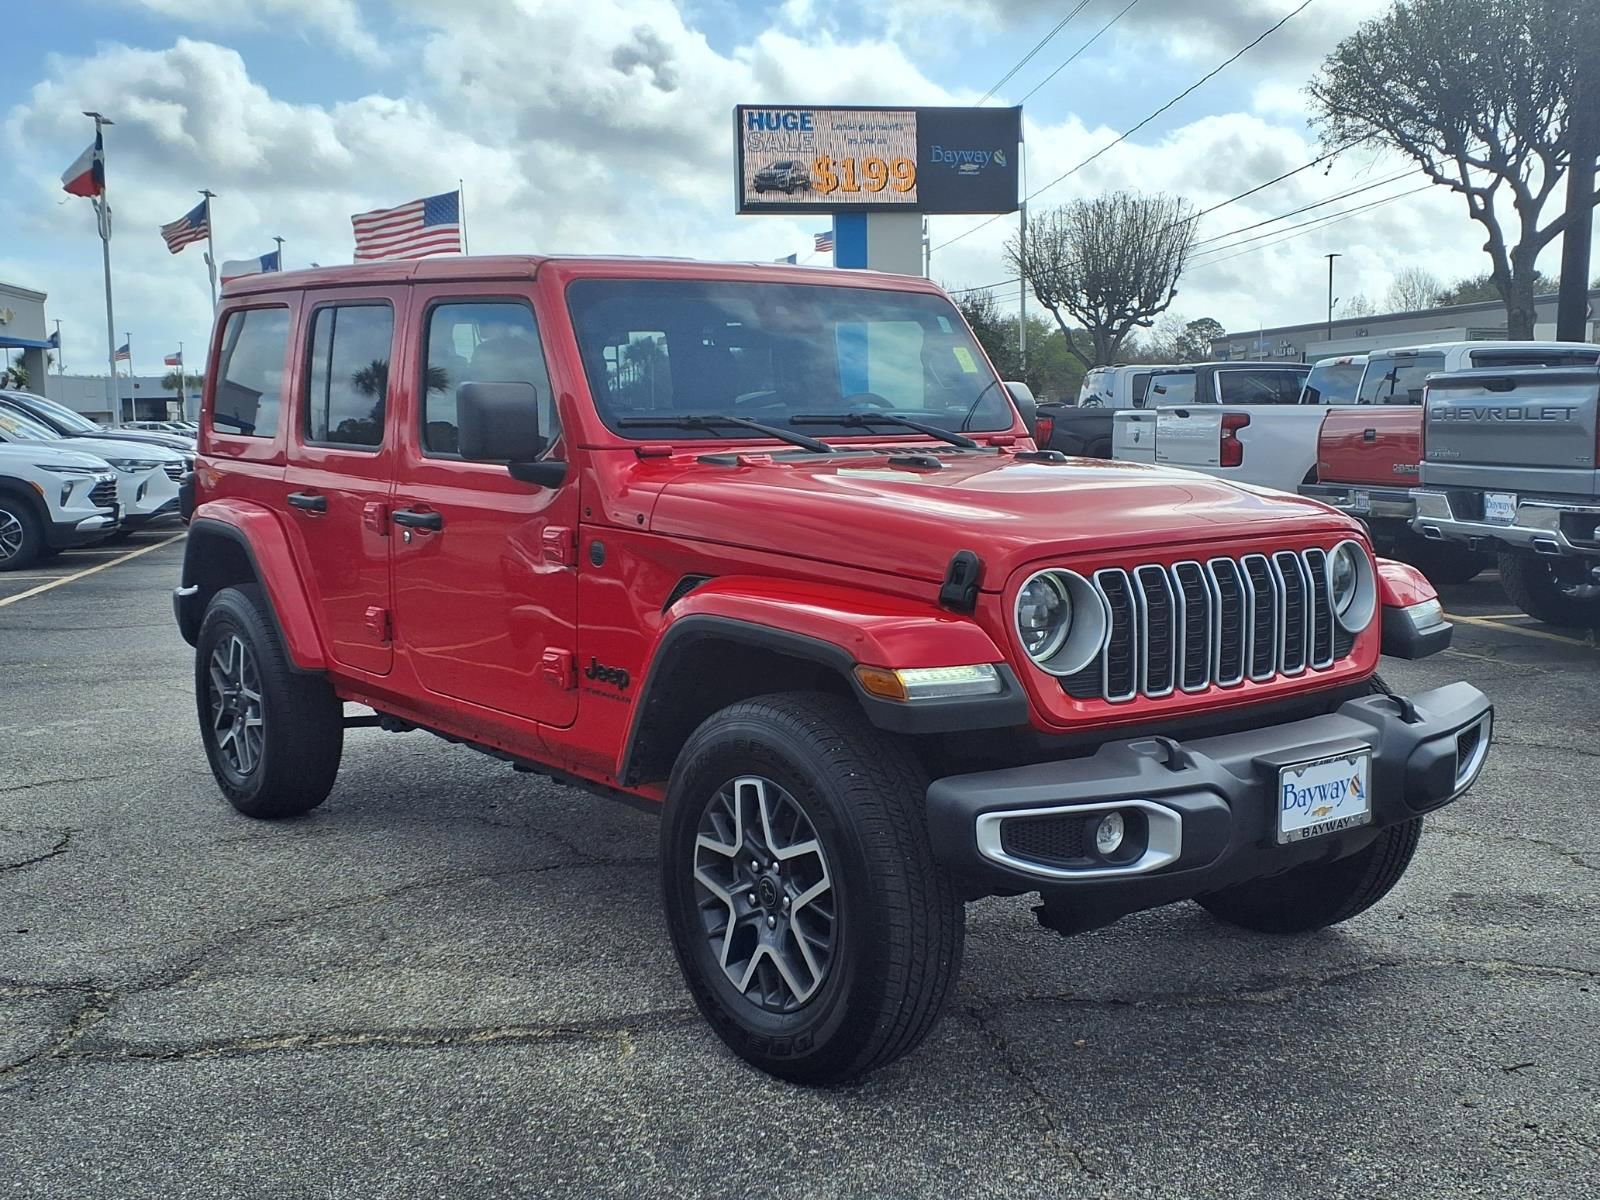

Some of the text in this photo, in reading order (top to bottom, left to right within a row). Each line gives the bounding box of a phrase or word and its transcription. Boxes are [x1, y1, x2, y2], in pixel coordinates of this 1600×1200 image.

[747, 112, 814, 131] HUGE
[747, 132, 814, 153] SALE
[930, 145, 992, 169] Bayway
[812, 155, 917, 195] $199
[1431, 407, 1578, 422] CHEVROLET
[584, 655, 630, 690] Jeep
[1282, 778, 1351, 816] Bayway
[1302, 817, 1351, 838] BAYWAY
